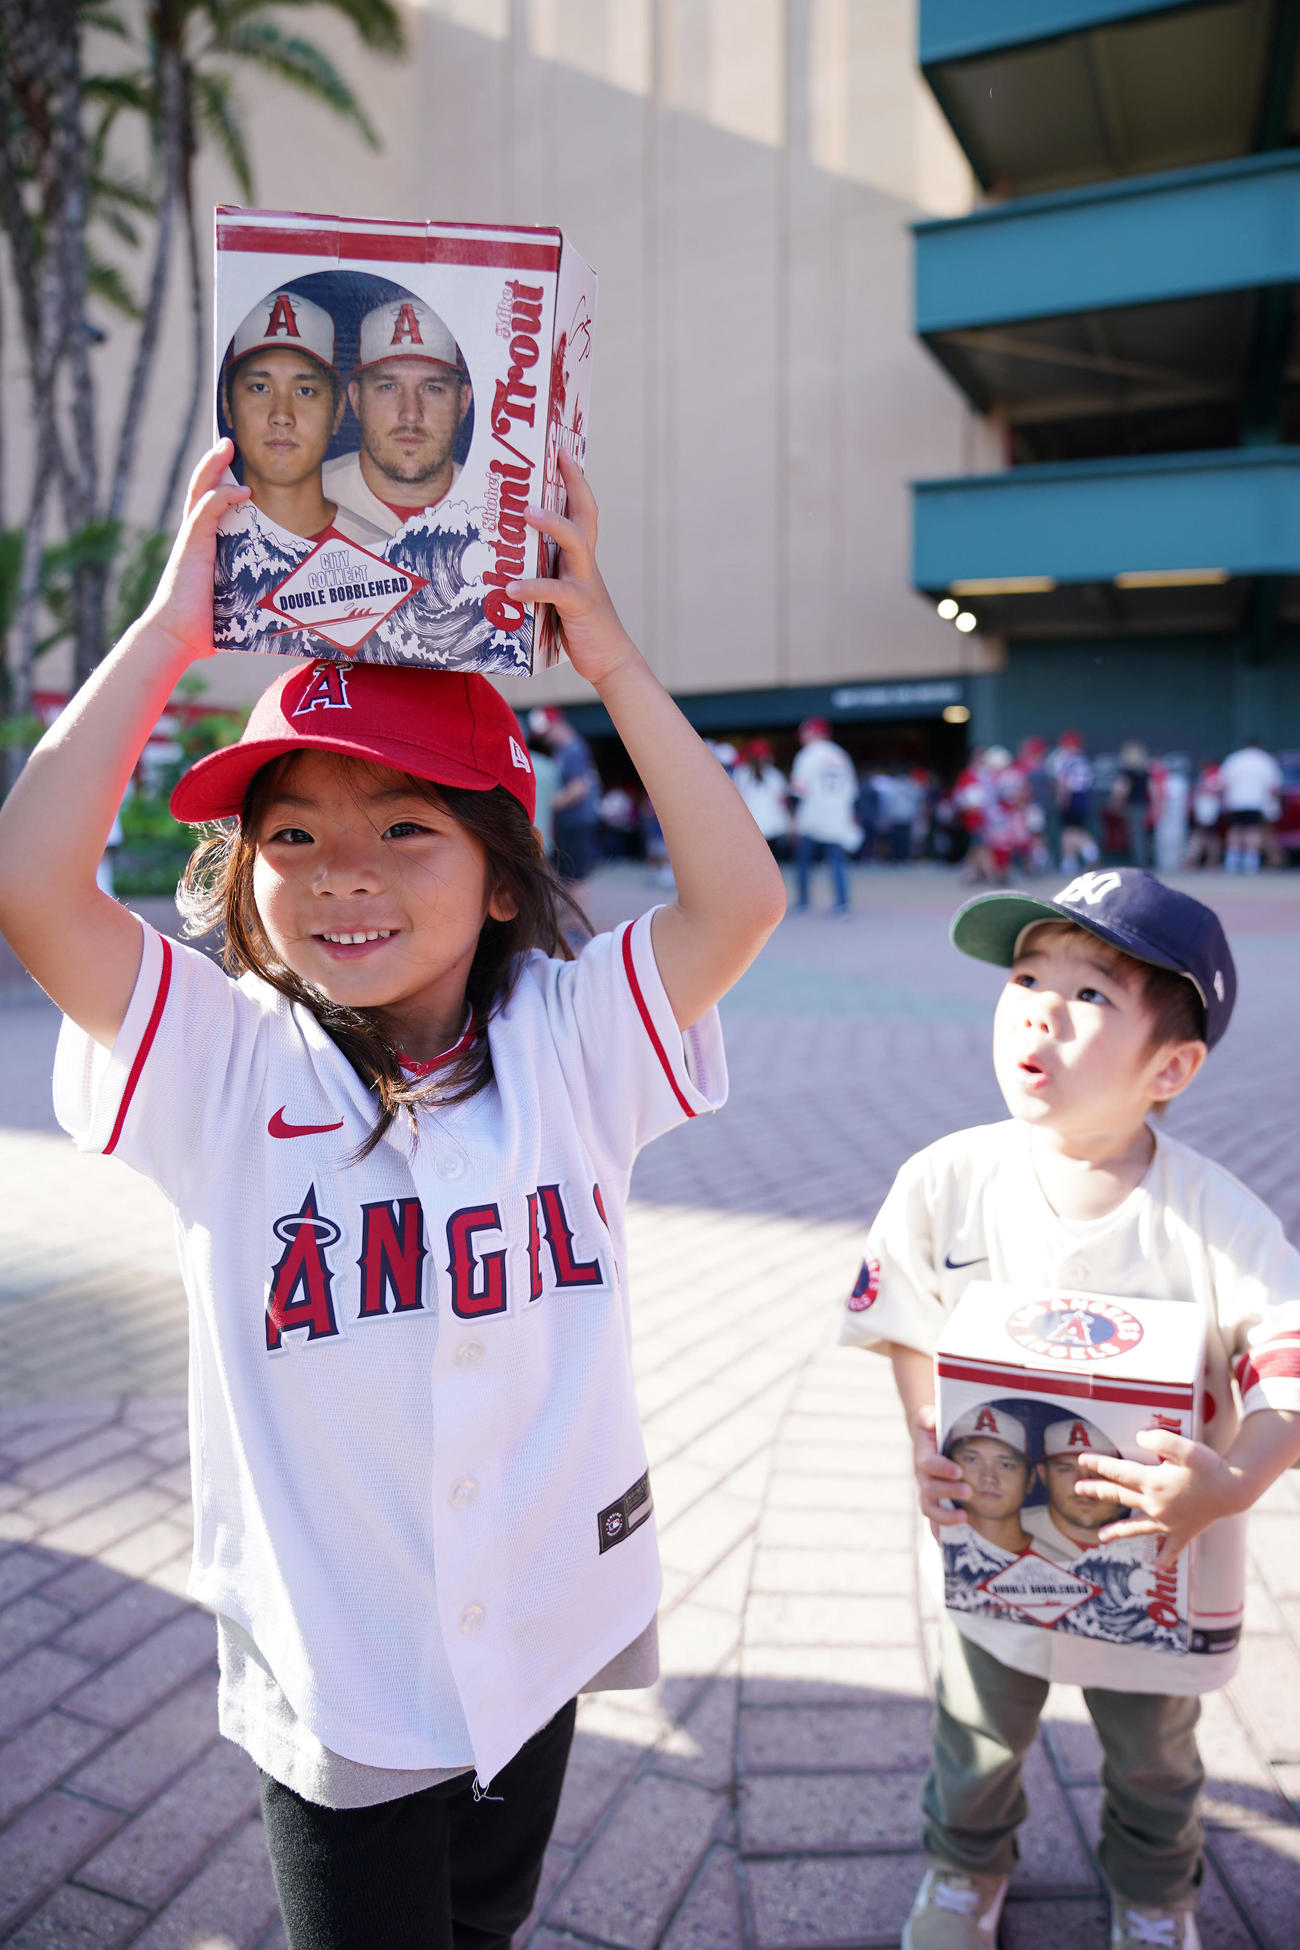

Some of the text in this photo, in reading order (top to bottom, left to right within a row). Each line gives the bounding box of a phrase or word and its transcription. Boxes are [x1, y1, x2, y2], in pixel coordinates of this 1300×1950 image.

[264, 295, 301, 337] A
[390, 304, 424, 345] A
[319, 550, 350, 570] CITY
[279, 577, 408, 611] DOUBLE BOBBLEHEAD
[308, 565, 368, 590] CONNECT
[291, 661, 353, 718] A
[266, 1181, 619, 1351] ANGL
[974, 1407, 998, 1433] A
[1068, 1420, 1091, 1447] A
